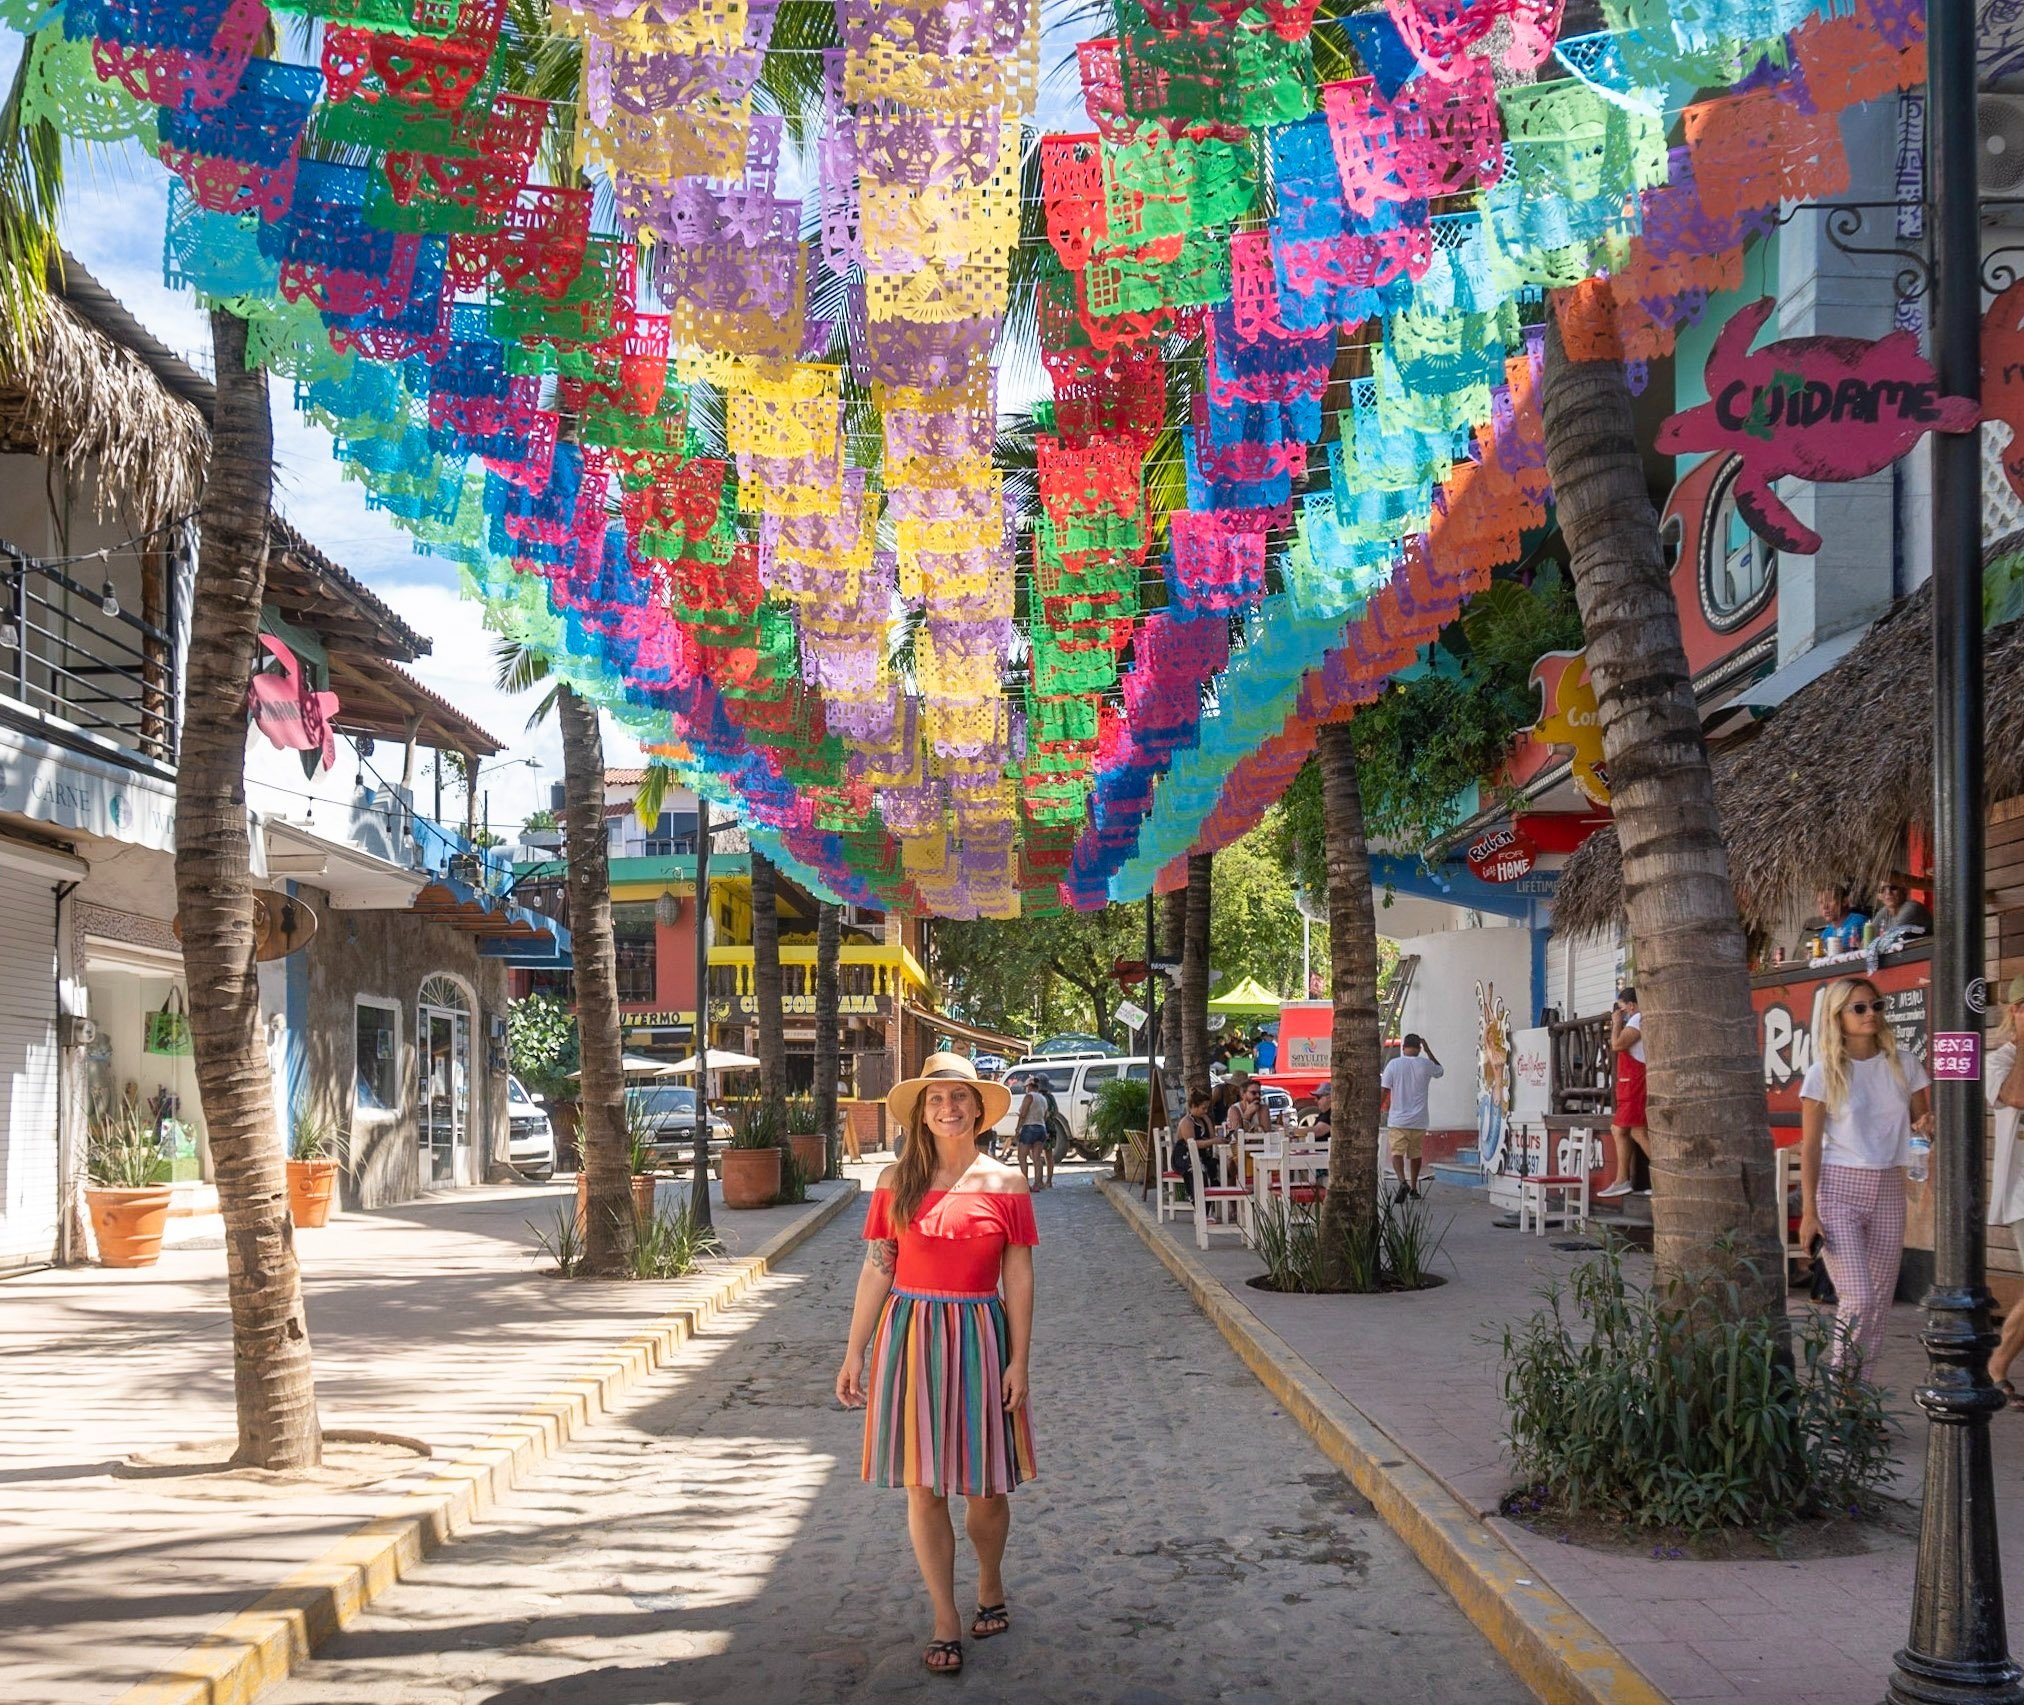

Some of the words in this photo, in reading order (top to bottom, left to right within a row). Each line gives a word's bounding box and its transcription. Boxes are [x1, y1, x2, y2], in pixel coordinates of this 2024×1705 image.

[1716, 378, 1941, 431] CUIDAME
[31, 775, 91, 812] CARNE
[1469, 830, 1515, 862] Ruben
[1498, 849, 1524, 860] FOR
[1497, 858, 1530, 881] HOME
